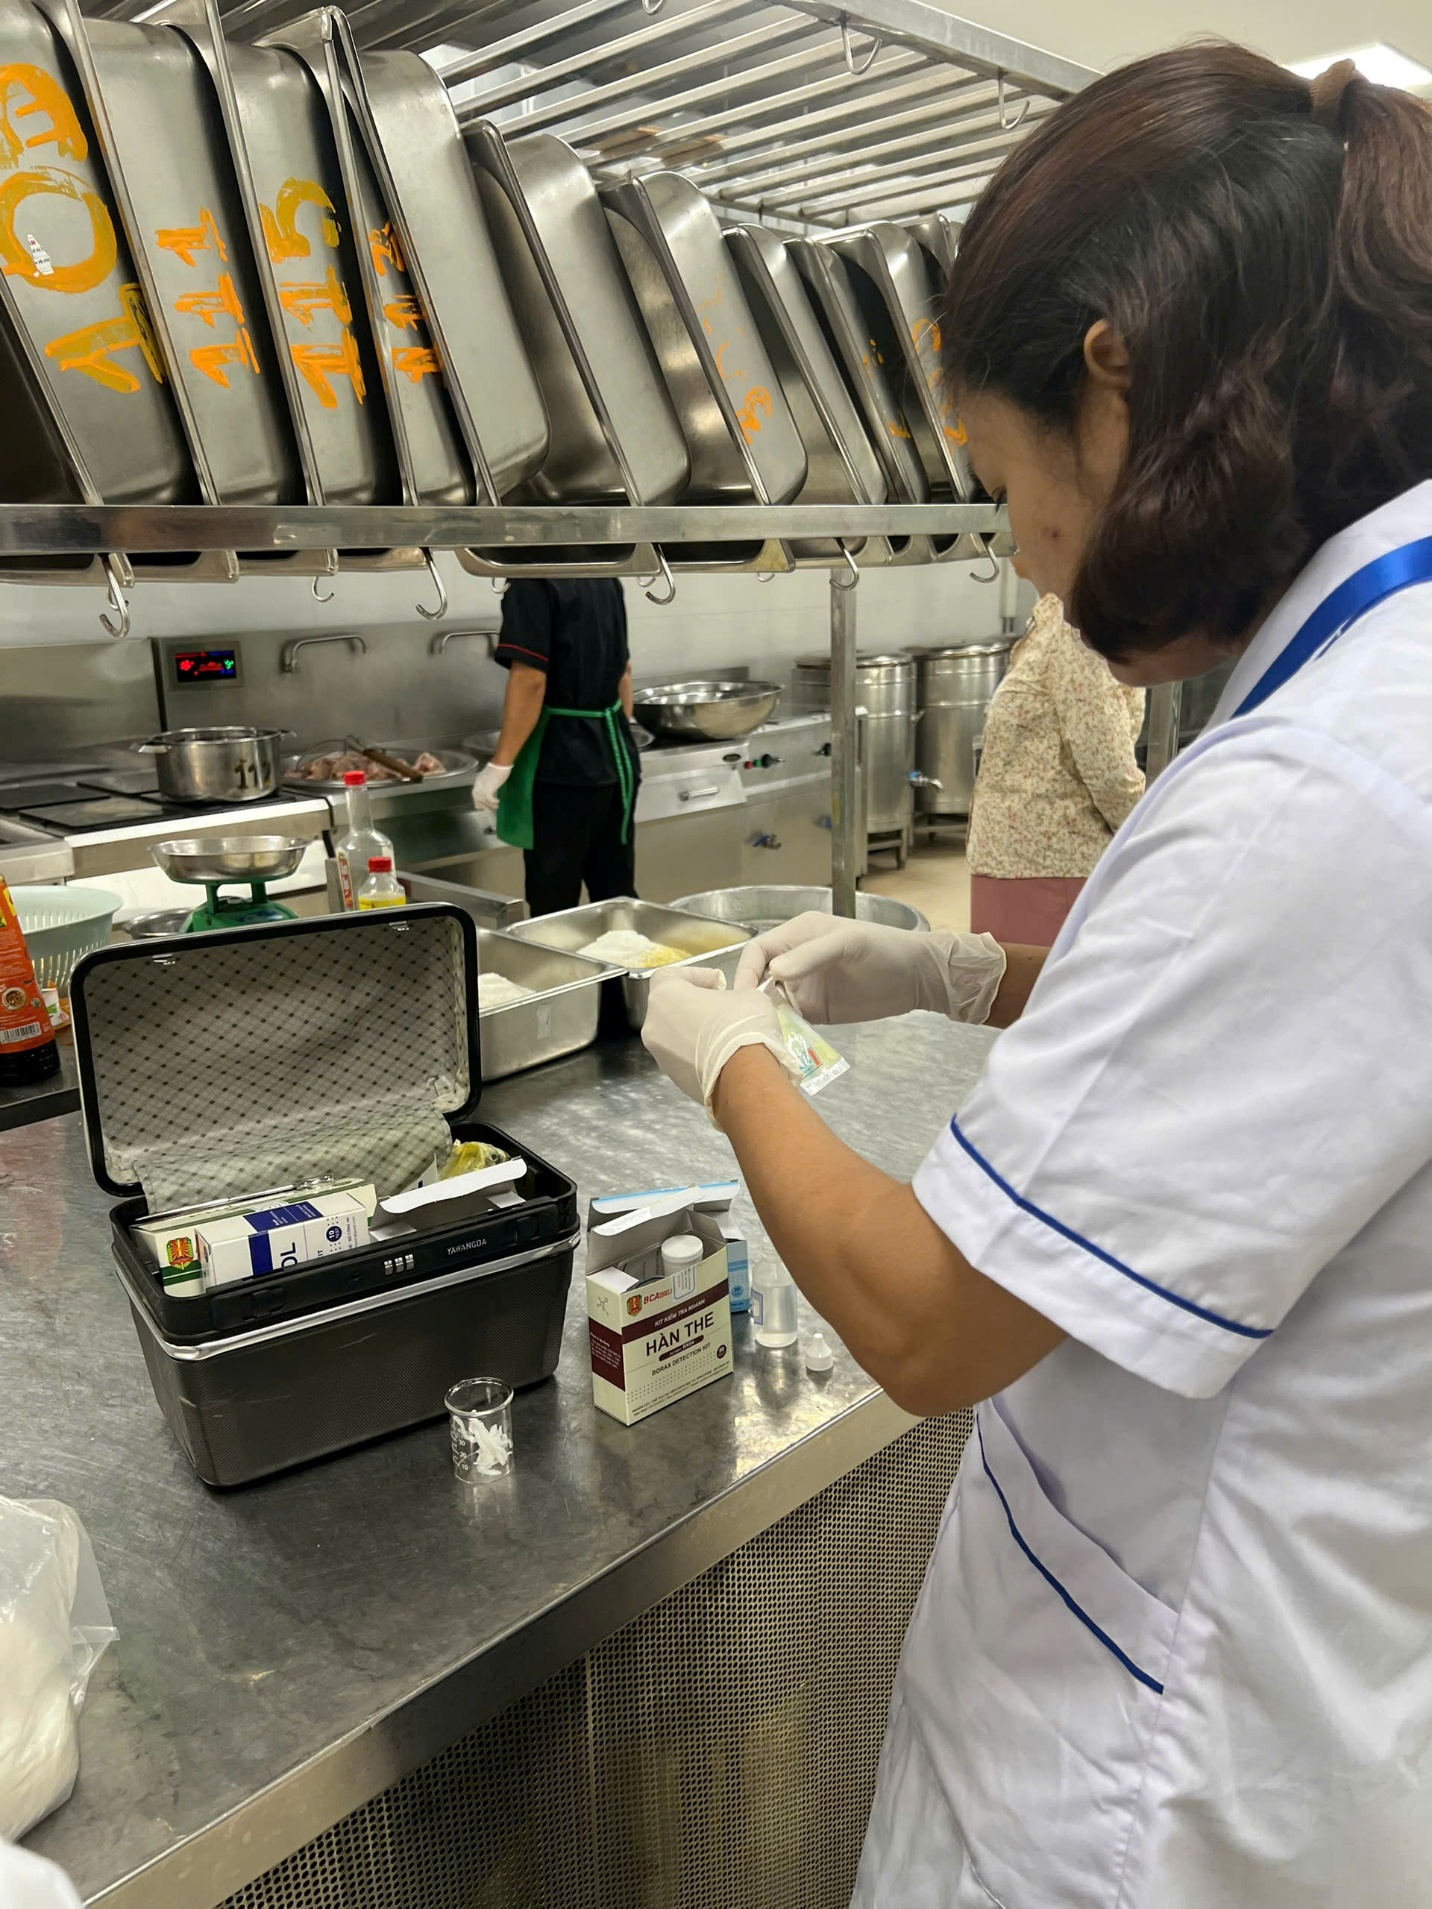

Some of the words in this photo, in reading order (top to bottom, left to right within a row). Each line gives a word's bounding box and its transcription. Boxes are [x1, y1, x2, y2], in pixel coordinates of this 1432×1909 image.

[328, 1230, 335, 1239] 10
[447, 1238, 487, 1256] YAWANGDA
[654, 1319, 664, 1327] KIT
[677, 1308, 688, 1317] TRA
[646, 1328, 680, 1356] HÀN
[684, 1311, 714, 1337] THE
[652, 1360, 671, 1376] BORAX
[672, 1346, 701, 1366] DETECTION
[702, 1342, 711, 1350] KIT
